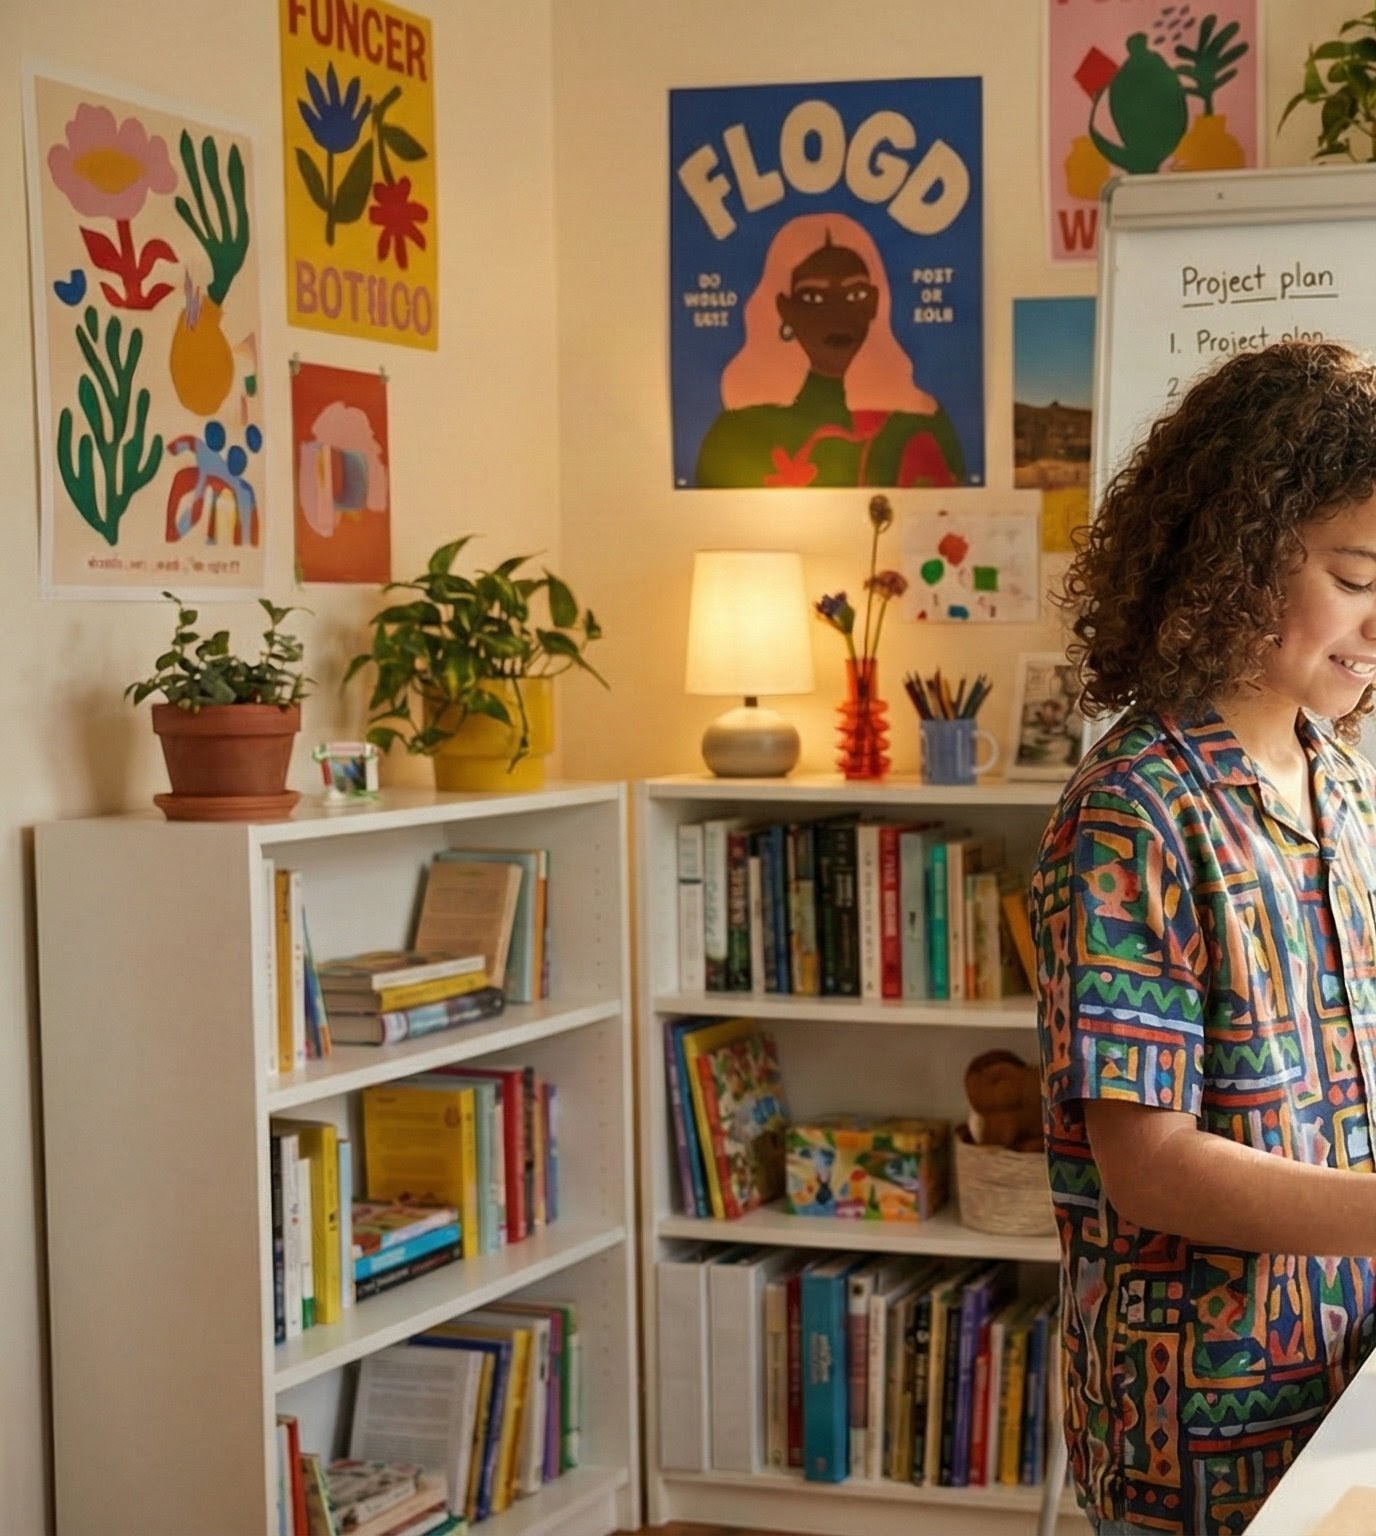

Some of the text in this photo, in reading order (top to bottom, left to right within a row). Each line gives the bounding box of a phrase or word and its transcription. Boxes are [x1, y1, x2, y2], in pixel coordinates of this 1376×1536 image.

[289, 0, 428, 82] FUNCER
[678, 100, 970, 241] FLOGD
[1182, 261, 1334, 304] Project plan
[1197, 325, 1269, 357] Project
